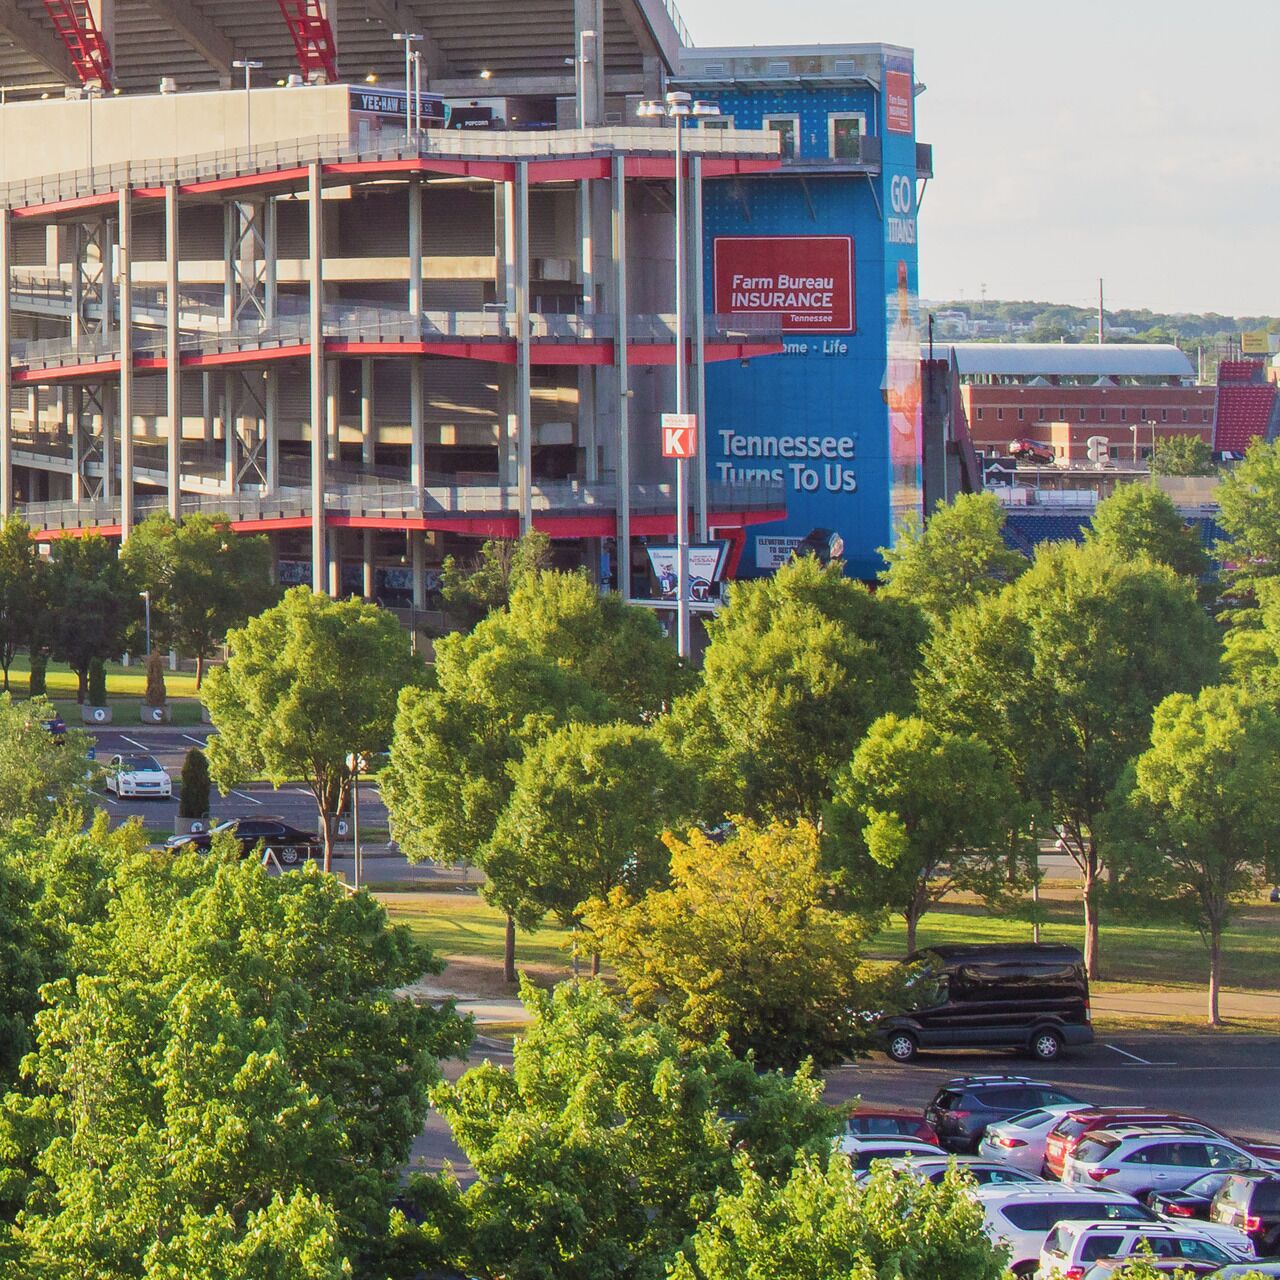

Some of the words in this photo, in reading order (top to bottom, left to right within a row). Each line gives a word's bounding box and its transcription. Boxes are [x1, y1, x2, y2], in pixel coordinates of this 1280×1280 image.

[891, 175, 911, 213] GO
[732, 275, 773, 289] Farm
[777, 275, 834, 289] Bureau
[731, 292, 834, 307] INSURANCE
[790, 314, 833, 322] Tennessee
[823, 340, 848, 353] Life
[665, 428, 685, 455] K
[718, 429, 855, 458] Tennessee
[715, 462, 784, 488] Turns
[789, 463, 819, 490] To
[824, 463, 857, 491] Us
